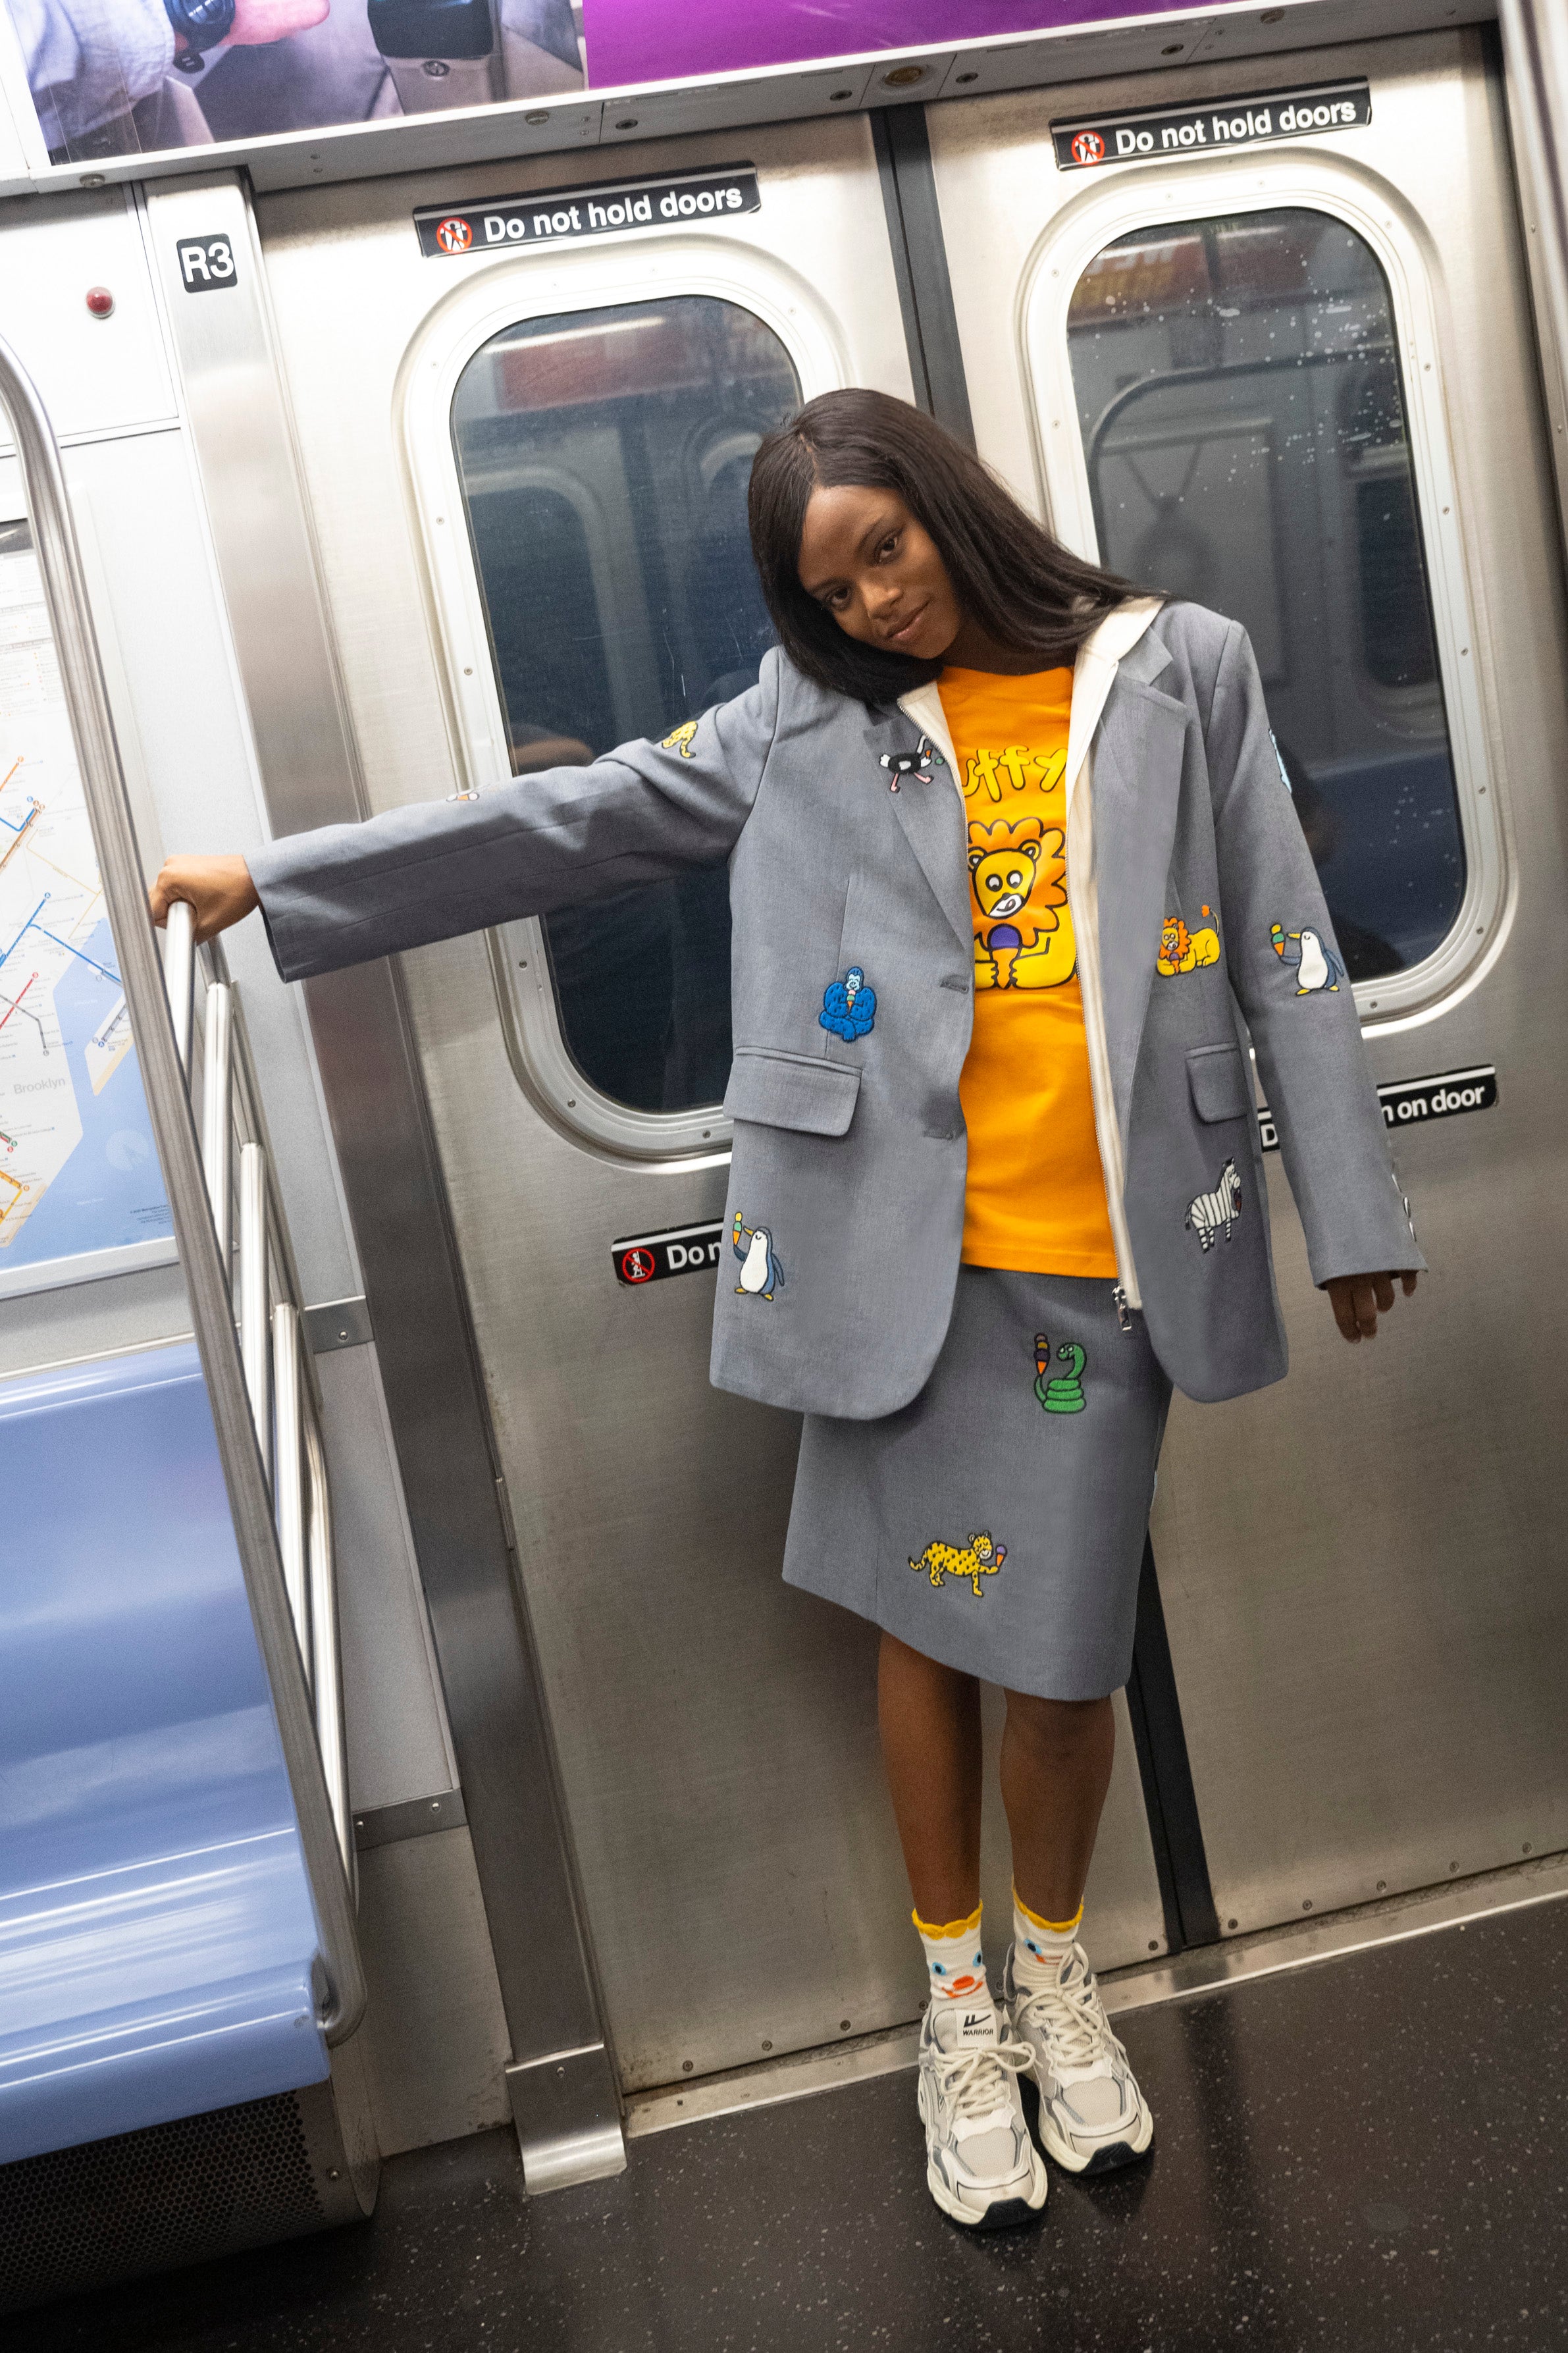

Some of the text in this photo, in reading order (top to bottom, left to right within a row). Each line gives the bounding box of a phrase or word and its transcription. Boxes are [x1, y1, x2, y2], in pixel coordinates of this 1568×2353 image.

[1115, 101, 1357, 156] Do not hold doors
[483, 187, 743, 243] Do not hold doors
[181, 242, 234, 283] R3
[13, 1078, 66, 1094] Brooklyn
[1397, 1097, 1428, 1121] on
[1431, 1084, 1485, 1113] door
[666, 1244, 704, 1270] Do
